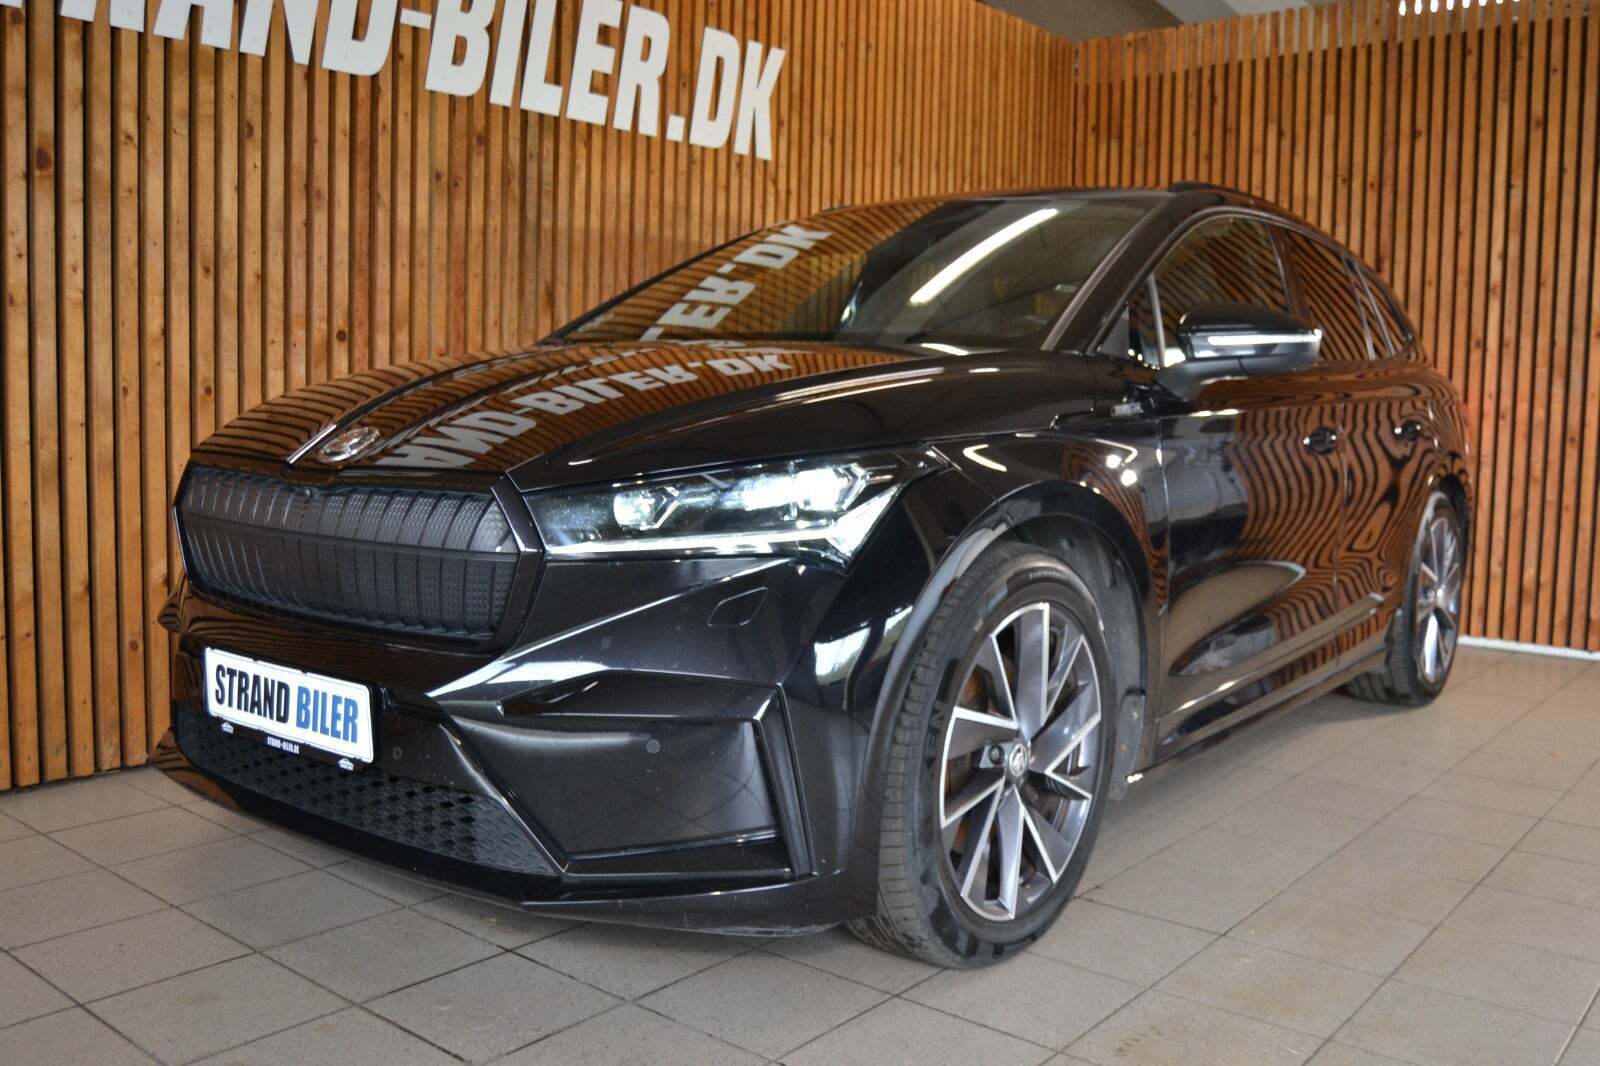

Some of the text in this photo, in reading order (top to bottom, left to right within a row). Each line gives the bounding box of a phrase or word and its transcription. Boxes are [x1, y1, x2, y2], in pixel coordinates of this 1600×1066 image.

[0, 0, 785, 161] D-BILER.DK
[215, 664, 359, 744] STRAND BILER
